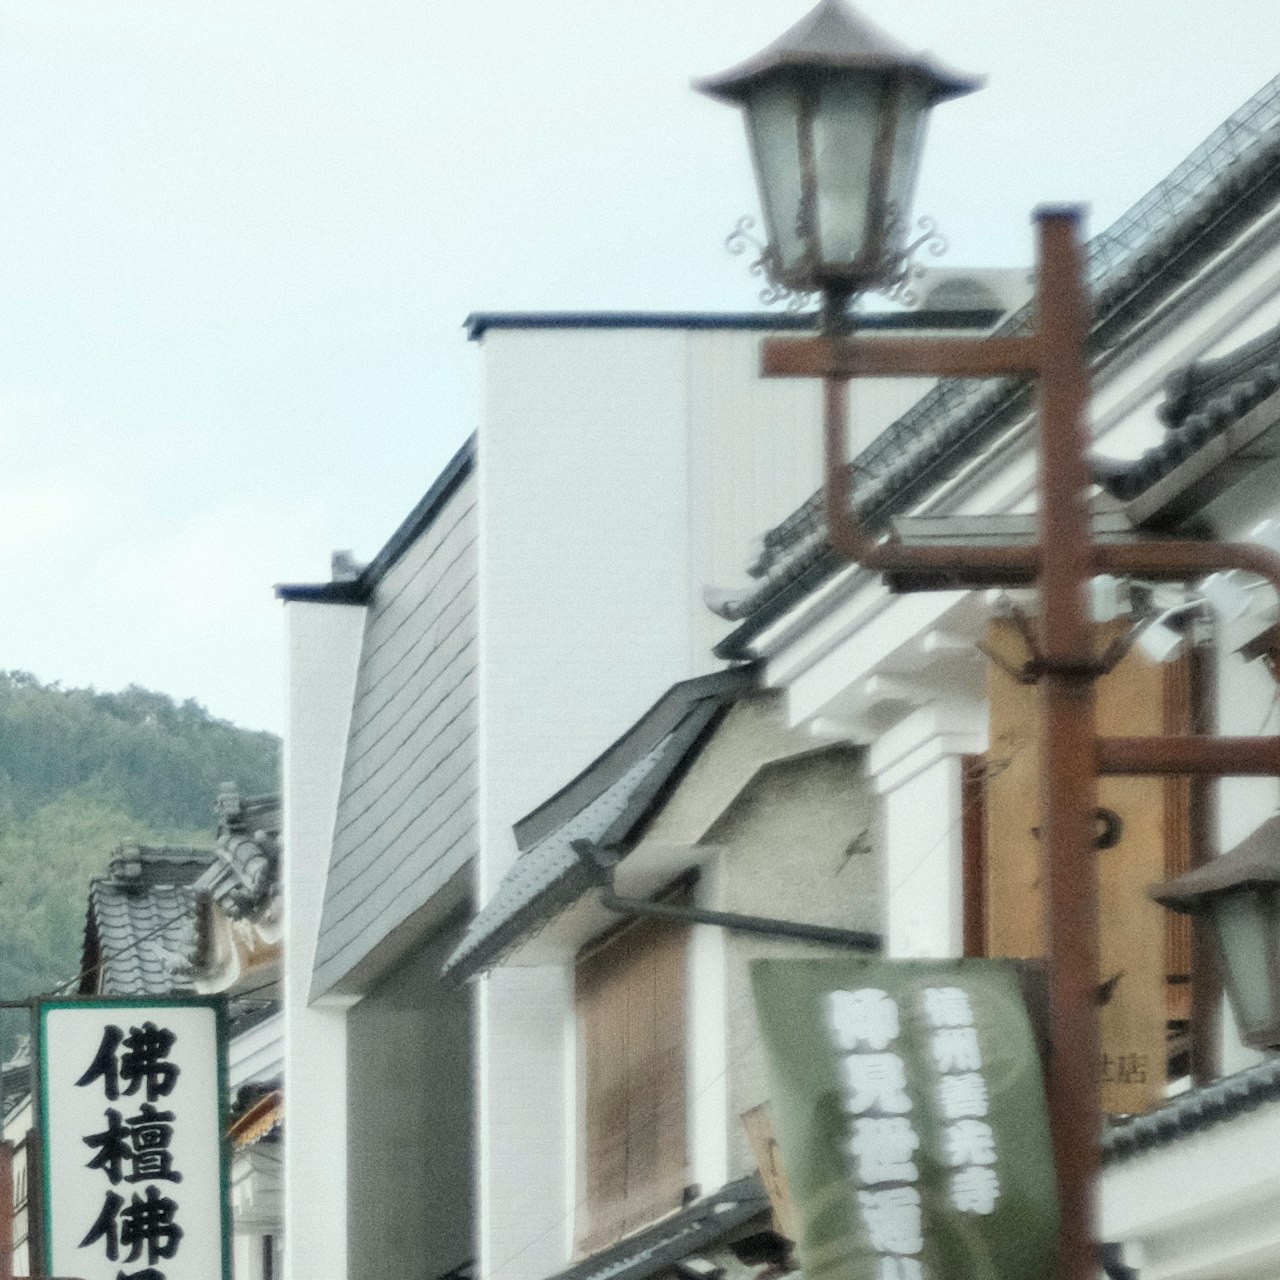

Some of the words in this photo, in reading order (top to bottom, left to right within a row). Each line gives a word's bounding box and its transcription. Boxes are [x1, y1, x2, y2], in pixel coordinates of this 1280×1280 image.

[922, 987, 1001, 1215] 信州善光寺
